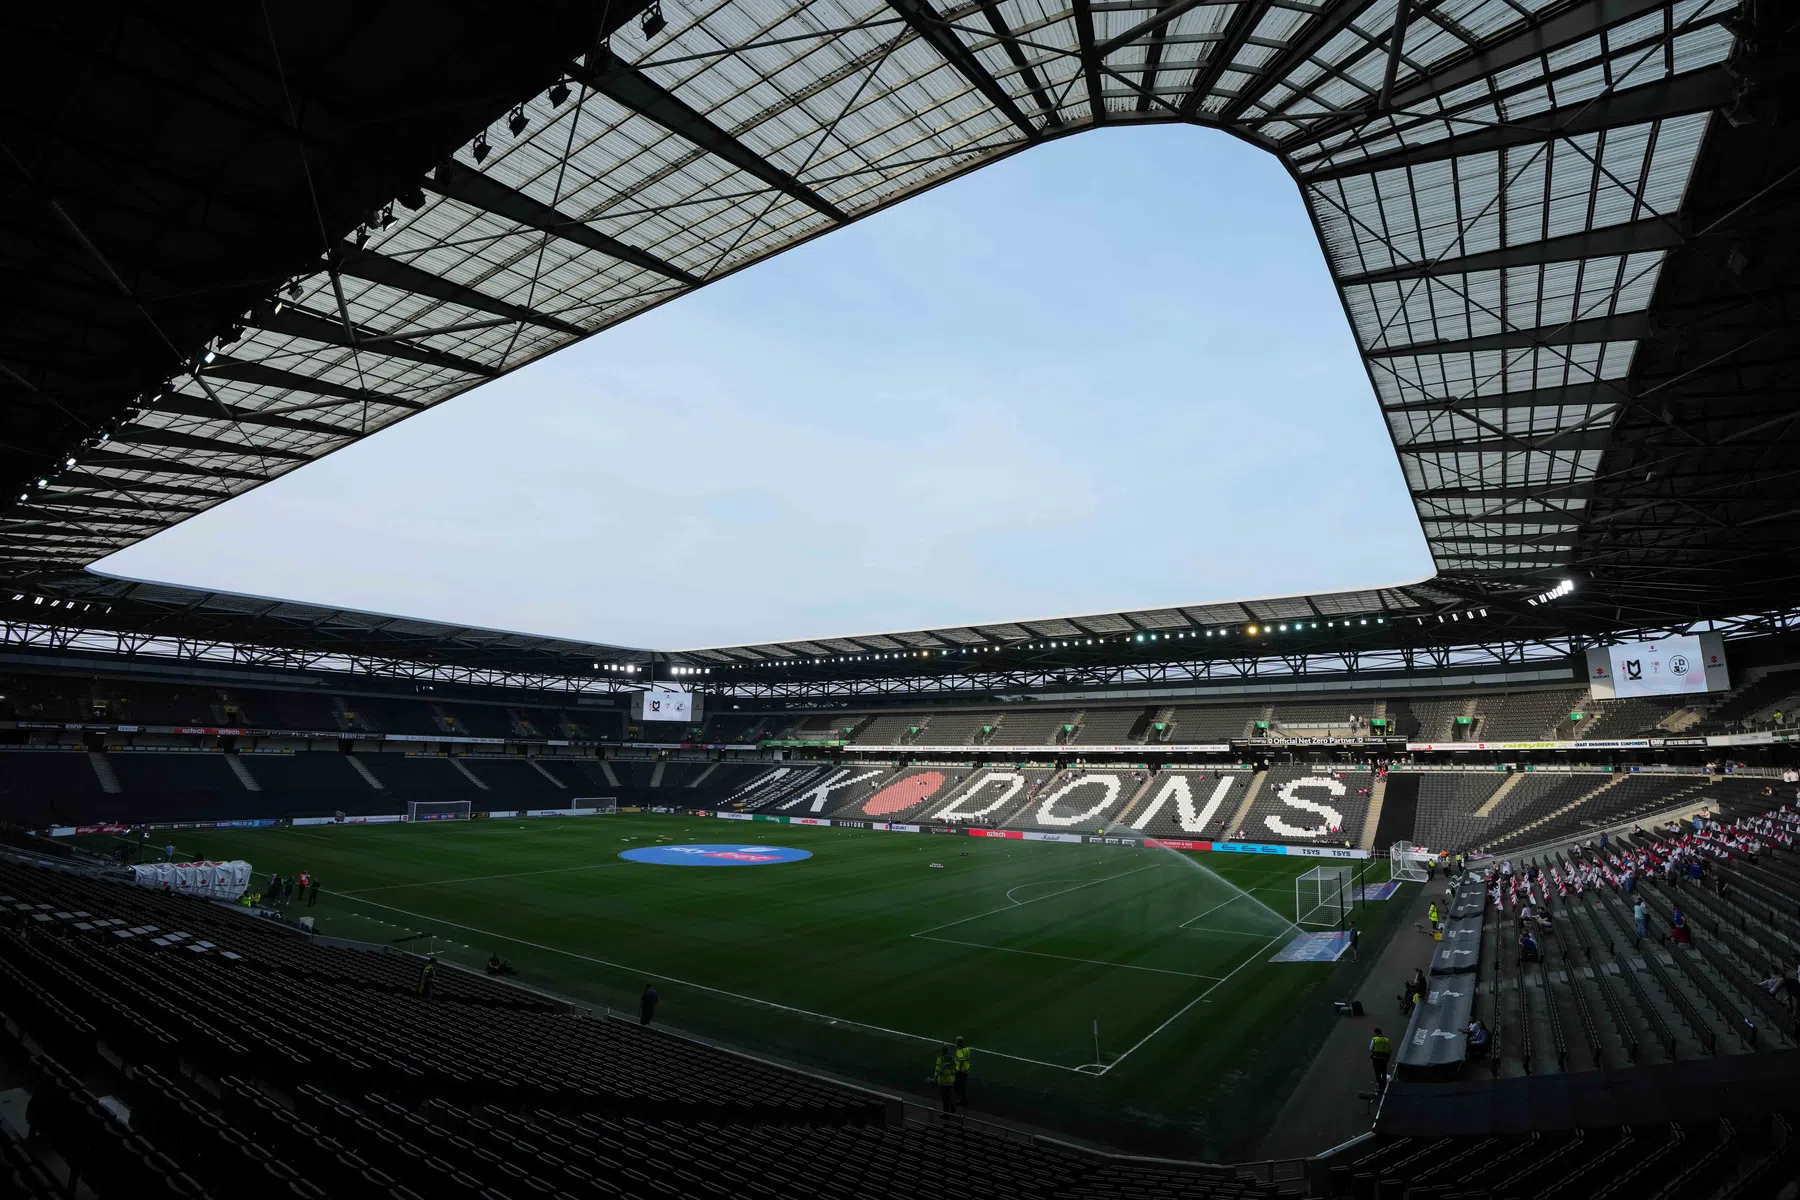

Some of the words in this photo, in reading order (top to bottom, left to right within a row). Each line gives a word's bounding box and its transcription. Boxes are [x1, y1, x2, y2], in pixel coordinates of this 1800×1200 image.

[1274, 737, 1297, 745] Official
[1502, 742, 1555, 750] niftylift
[931, 771, 1347, 837] DONS
[986, 830, 1006, 838] aztech
